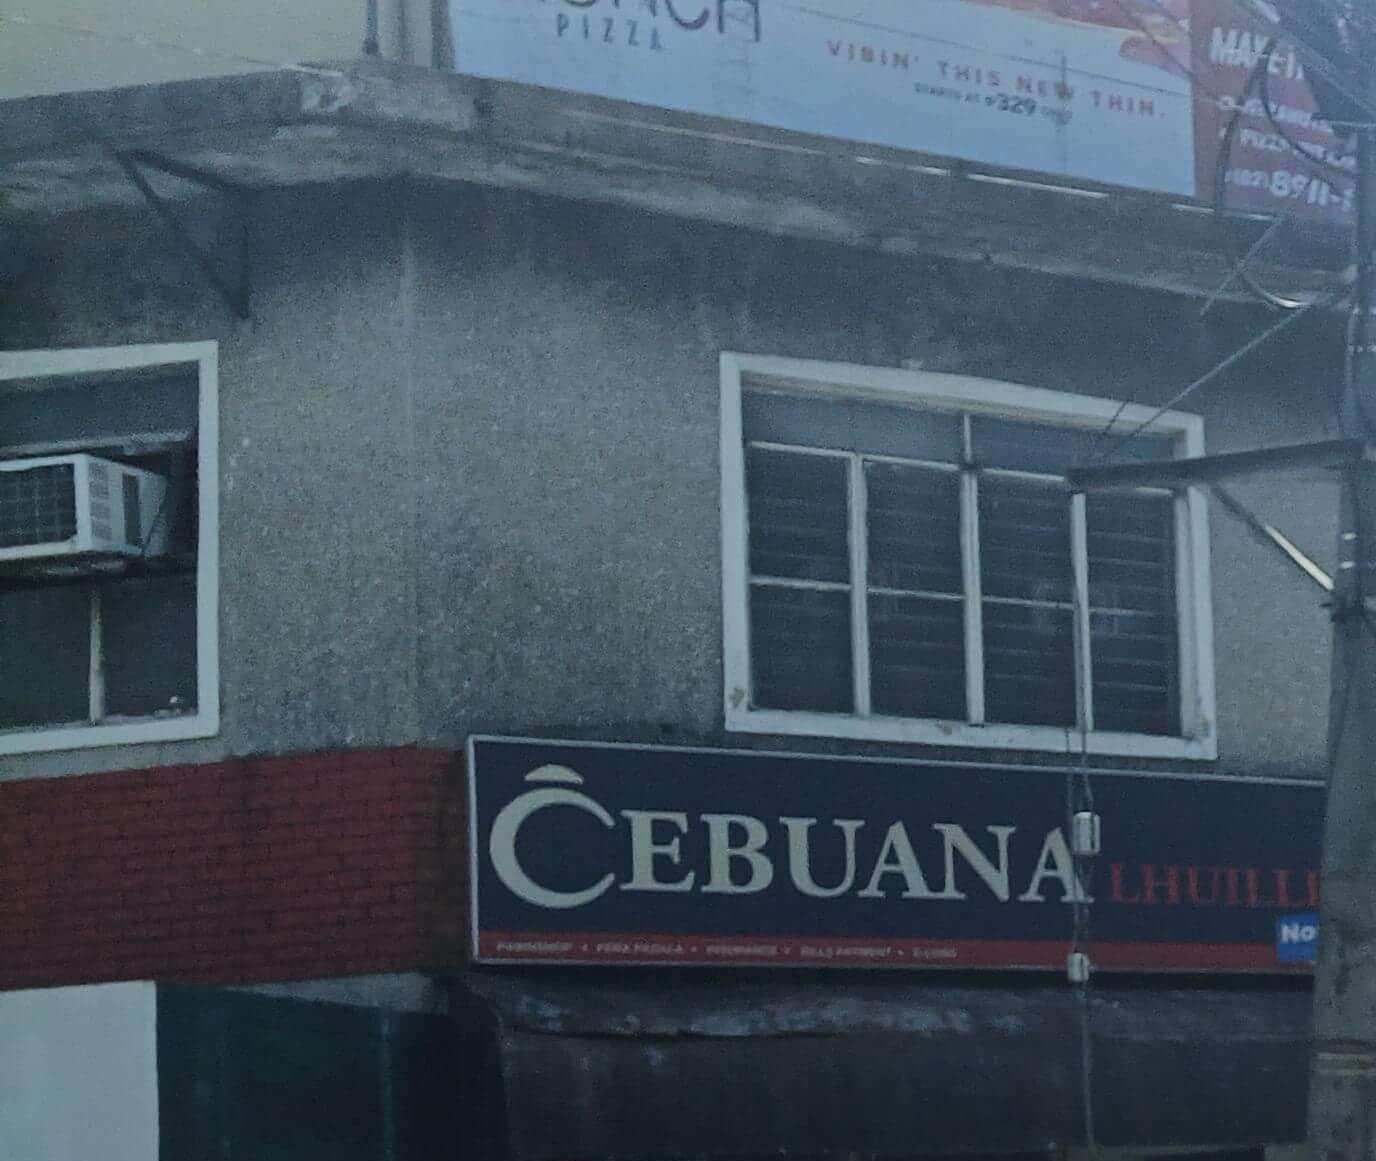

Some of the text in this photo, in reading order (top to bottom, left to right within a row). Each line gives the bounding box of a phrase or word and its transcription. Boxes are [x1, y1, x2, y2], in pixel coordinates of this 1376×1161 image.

[556, 13, 665, 50] PIZZA
[937, 60, 1001, 87] THIS
[488, 764, 1095, 910] CEBUANA
